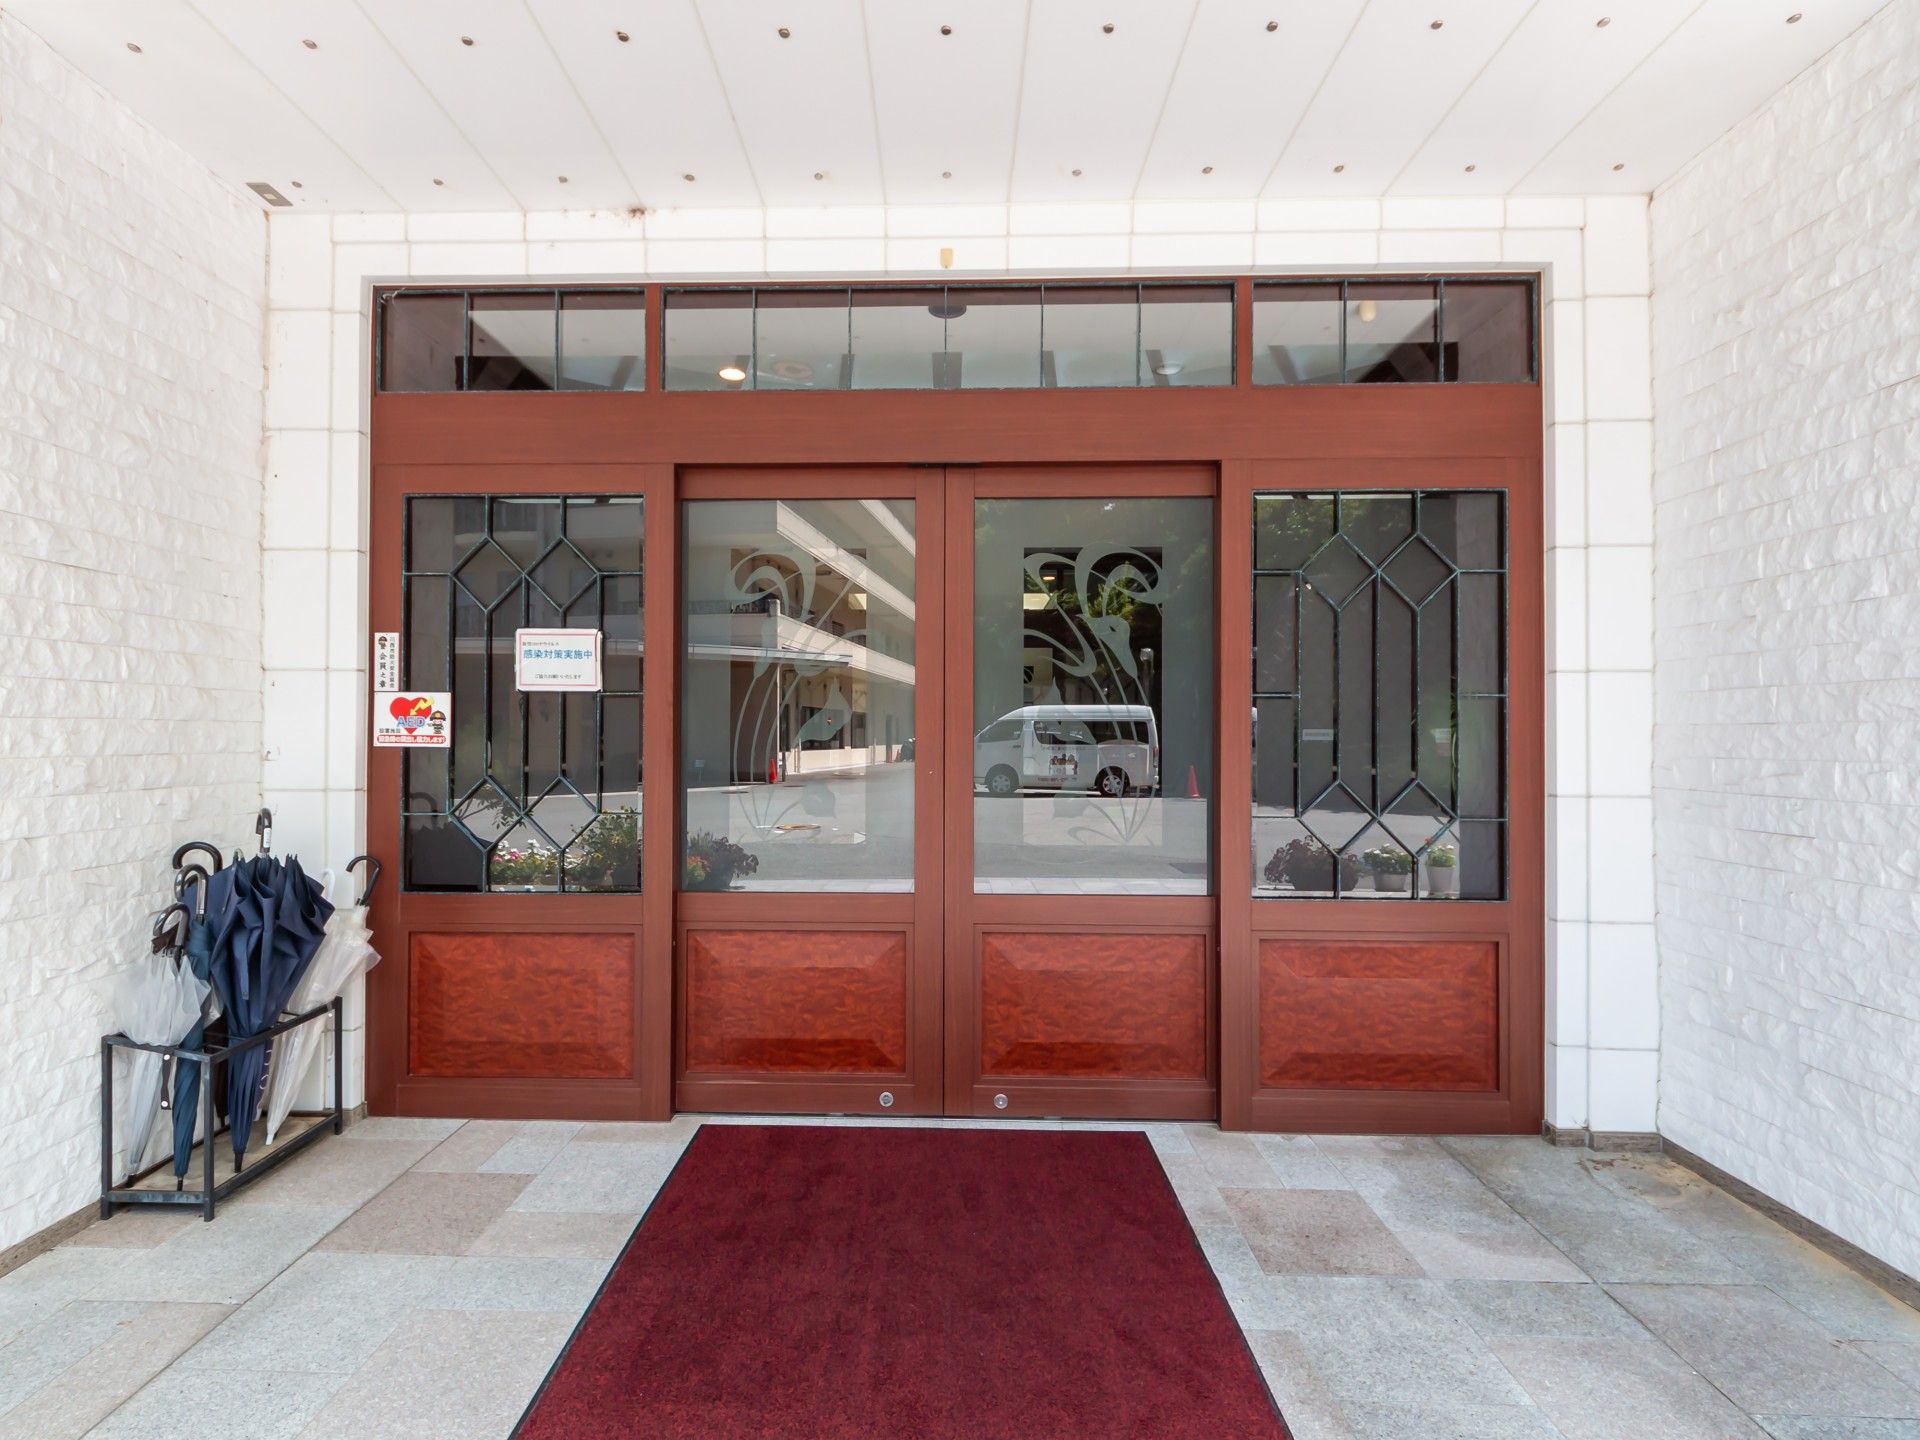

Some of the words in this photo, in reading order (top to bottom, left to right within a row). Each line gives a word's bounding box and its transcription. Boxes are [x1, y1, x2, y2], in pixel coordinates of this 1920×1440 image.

[523, 649, 593, 659] 感染対策実施中
[397, 716, 426, 728] AED
